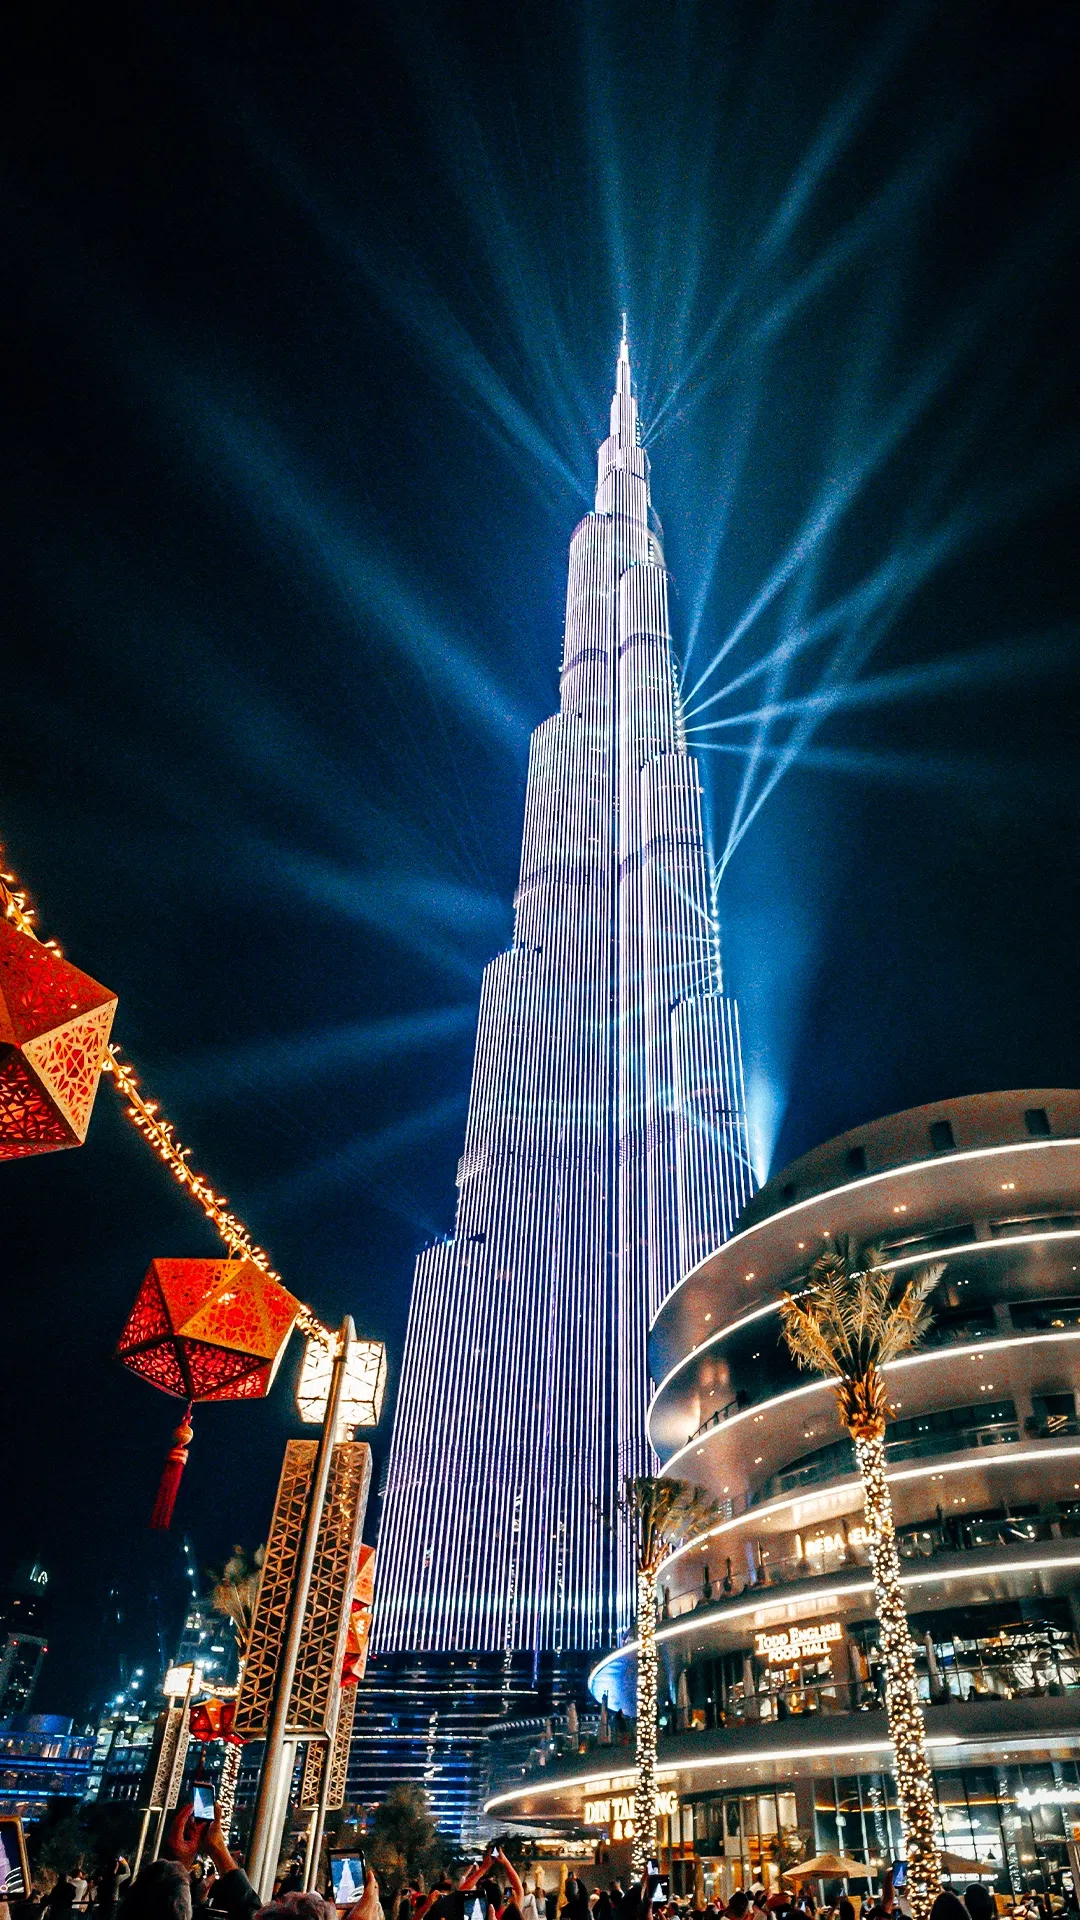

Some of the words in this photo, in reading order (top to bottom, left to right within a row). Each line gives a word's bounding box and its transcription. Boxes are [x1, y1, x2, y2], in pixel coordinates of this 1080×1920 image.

[768, 1645, 800, 1663] FOOD
[802, 1641, 831, 1656] HALL
[584, 1801, 611, 1824] DIN
[611, 1796, 635, 1820] TAI
